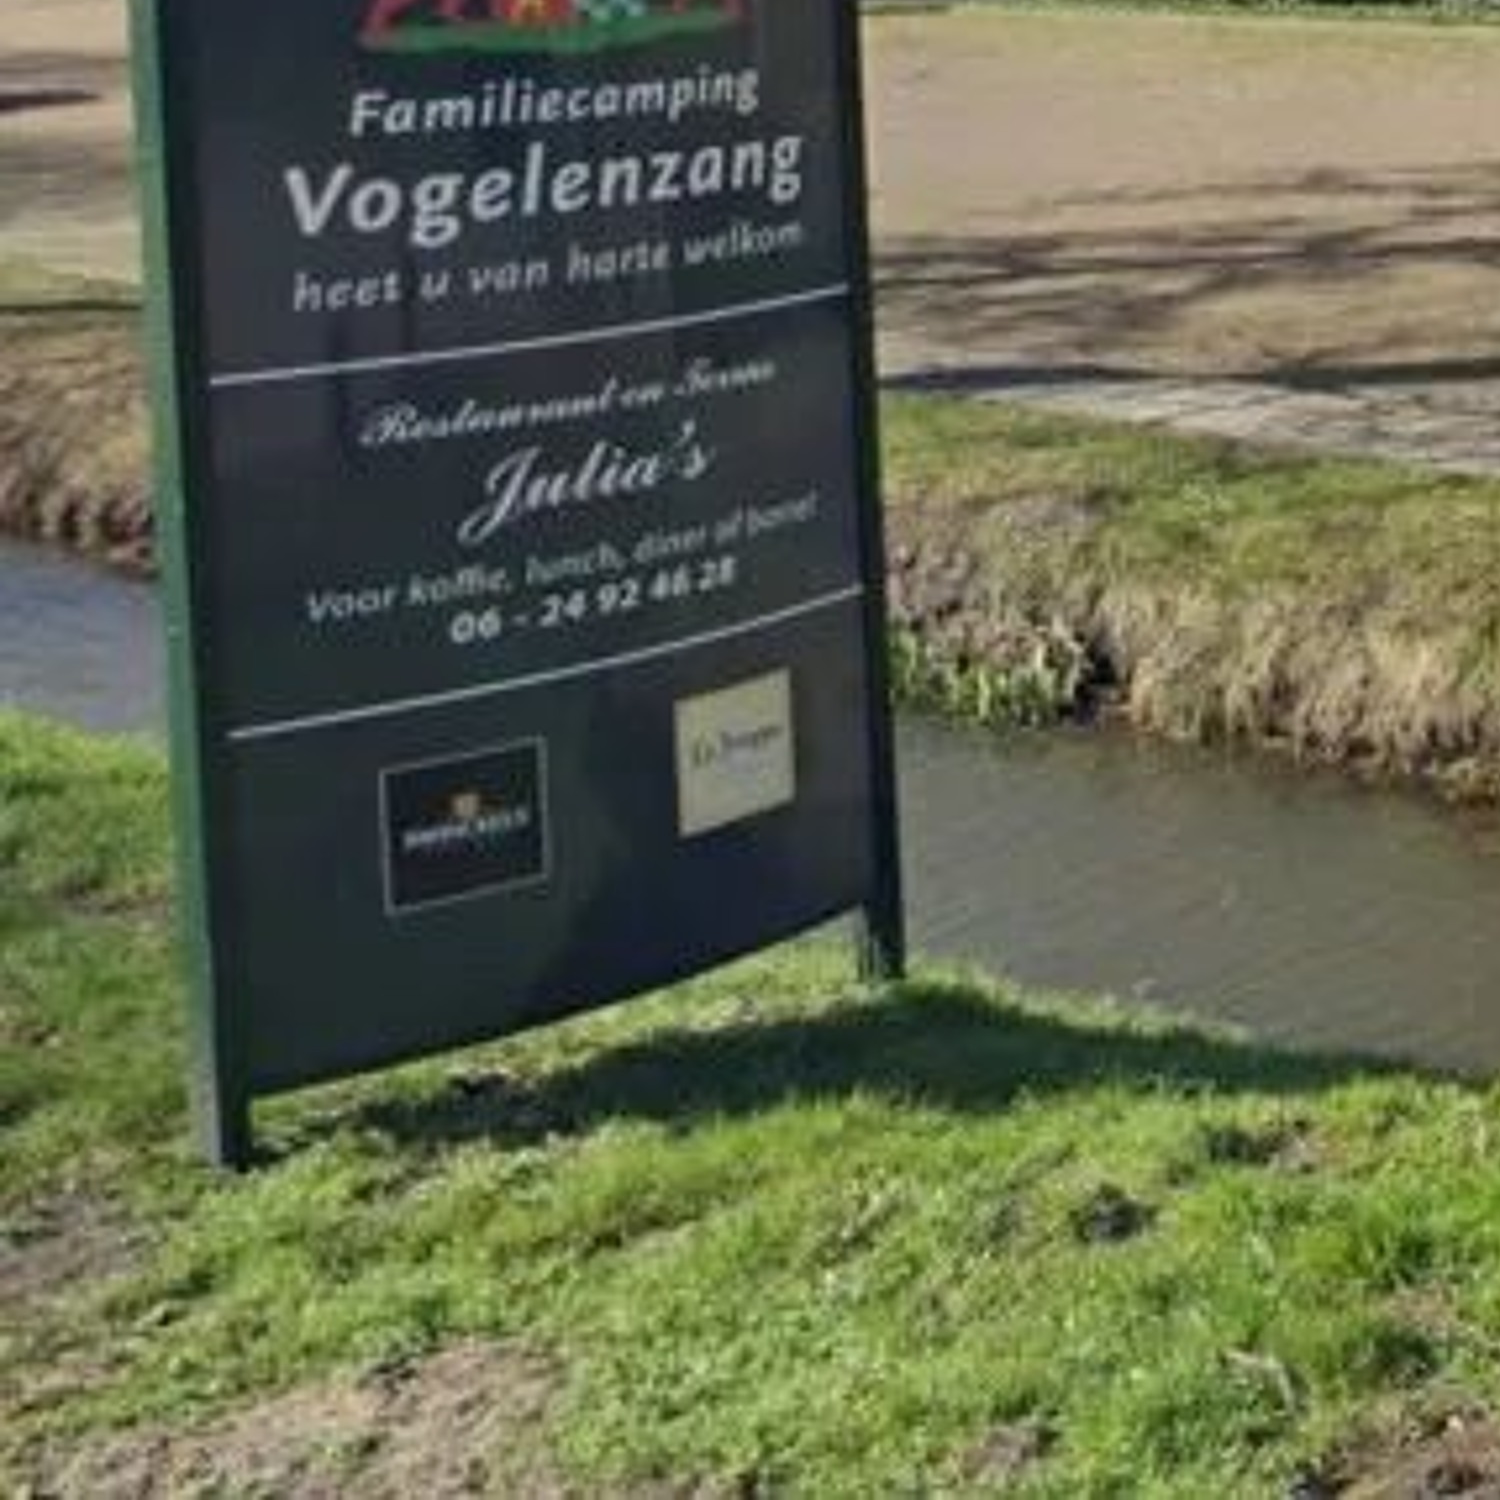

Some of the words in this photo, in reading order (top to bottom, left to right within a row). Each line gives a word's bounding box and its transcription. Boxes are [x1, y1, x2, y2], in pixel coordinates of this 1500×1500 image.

[349, 66, 761, 137] Familiecamping
[284, 134, 802, 249] Vogelenzang
[293, 271, 400, 312] heet
[419, 272, 450, 301] u
[467, 257, 551, 292] van
[566, 242, 671, 284] harte
[683, 219, 803, 266] welkom
[456, 420, 716, 546] Julia's
[449, 607, 502, 644] 06
